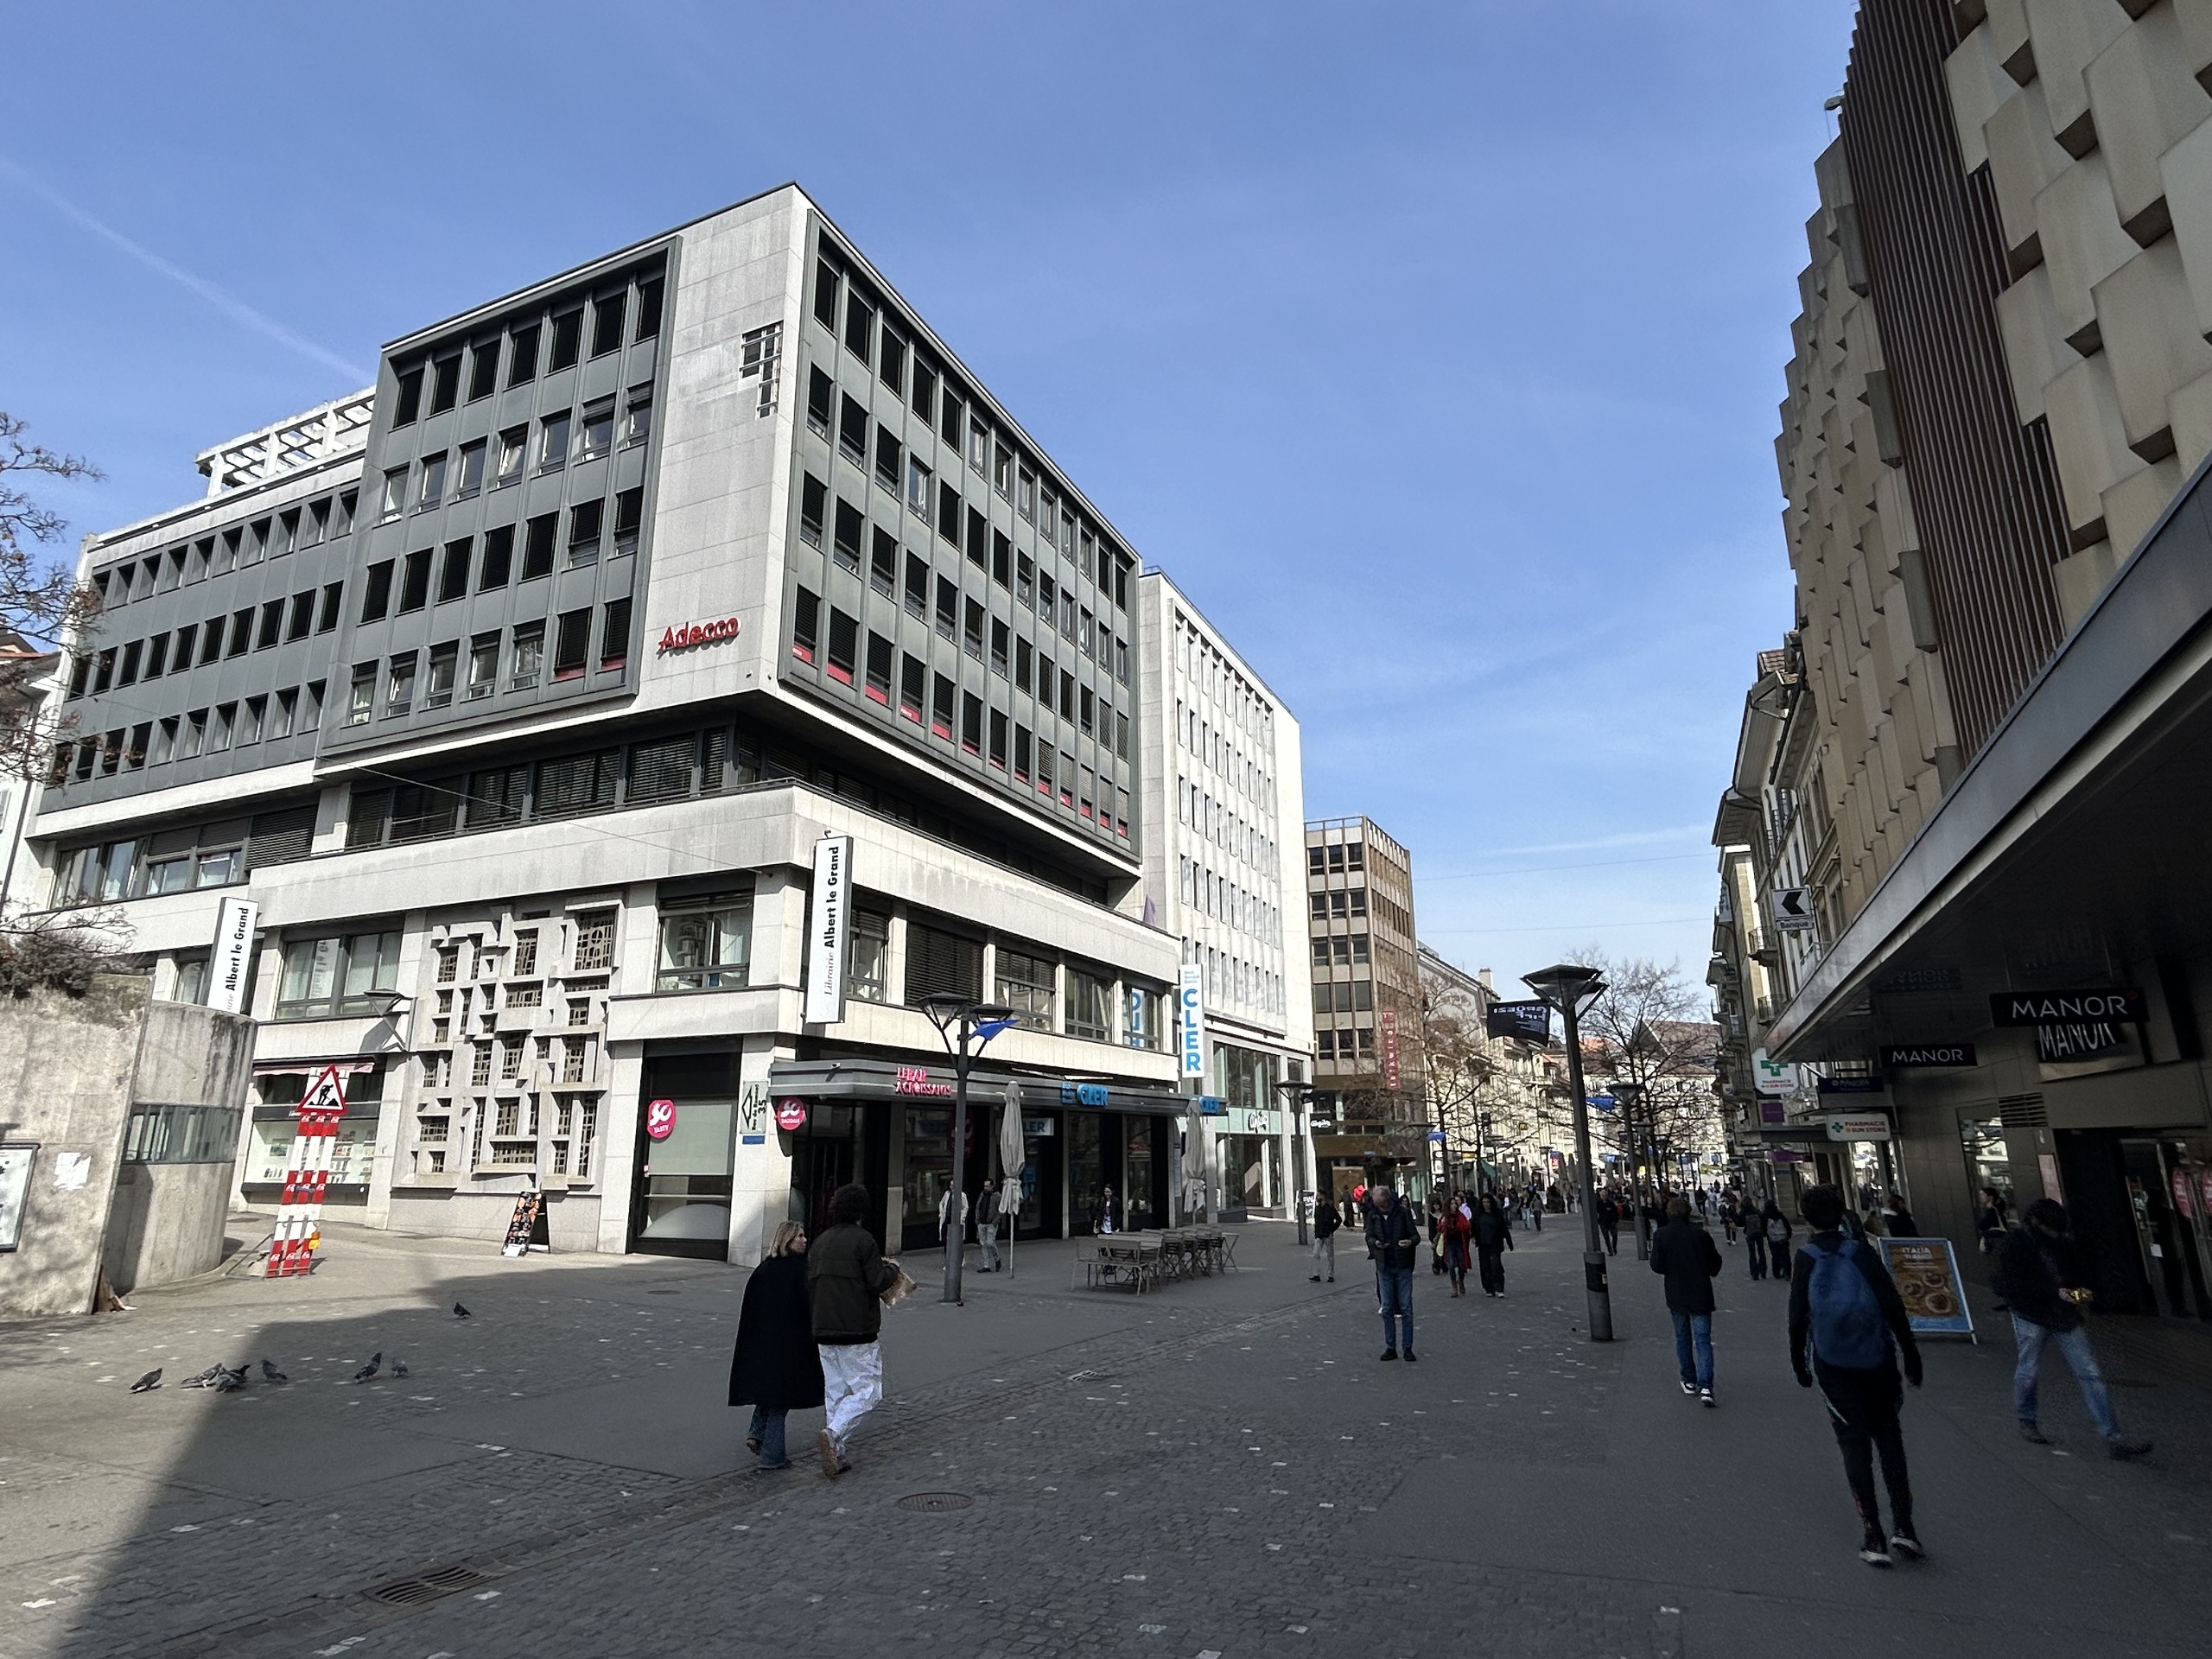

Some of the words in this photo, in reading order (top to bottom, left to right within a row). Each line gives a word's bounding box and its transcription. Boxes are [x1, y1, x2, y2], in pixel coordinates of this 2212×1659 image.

[658, 617, 741, 651] Adecco
[827, 846, 840, 887] Grand
[826, 890, 837, 903] le
[233, 907, 250, 940] Grand
[823, 906, 836, 949] Albert
[230, 944, 243, 954] le
[225, 957, 241, 992] Albert
[2012, 995, 2128, 1019] MANOR
[1183, 988, 1202, 1071] CLER
[1891, 1048, 1964, 1063] MANOR
[757, 1099, 767, 1115] 35
[1077, 1083, 1109, 1106] CLER
